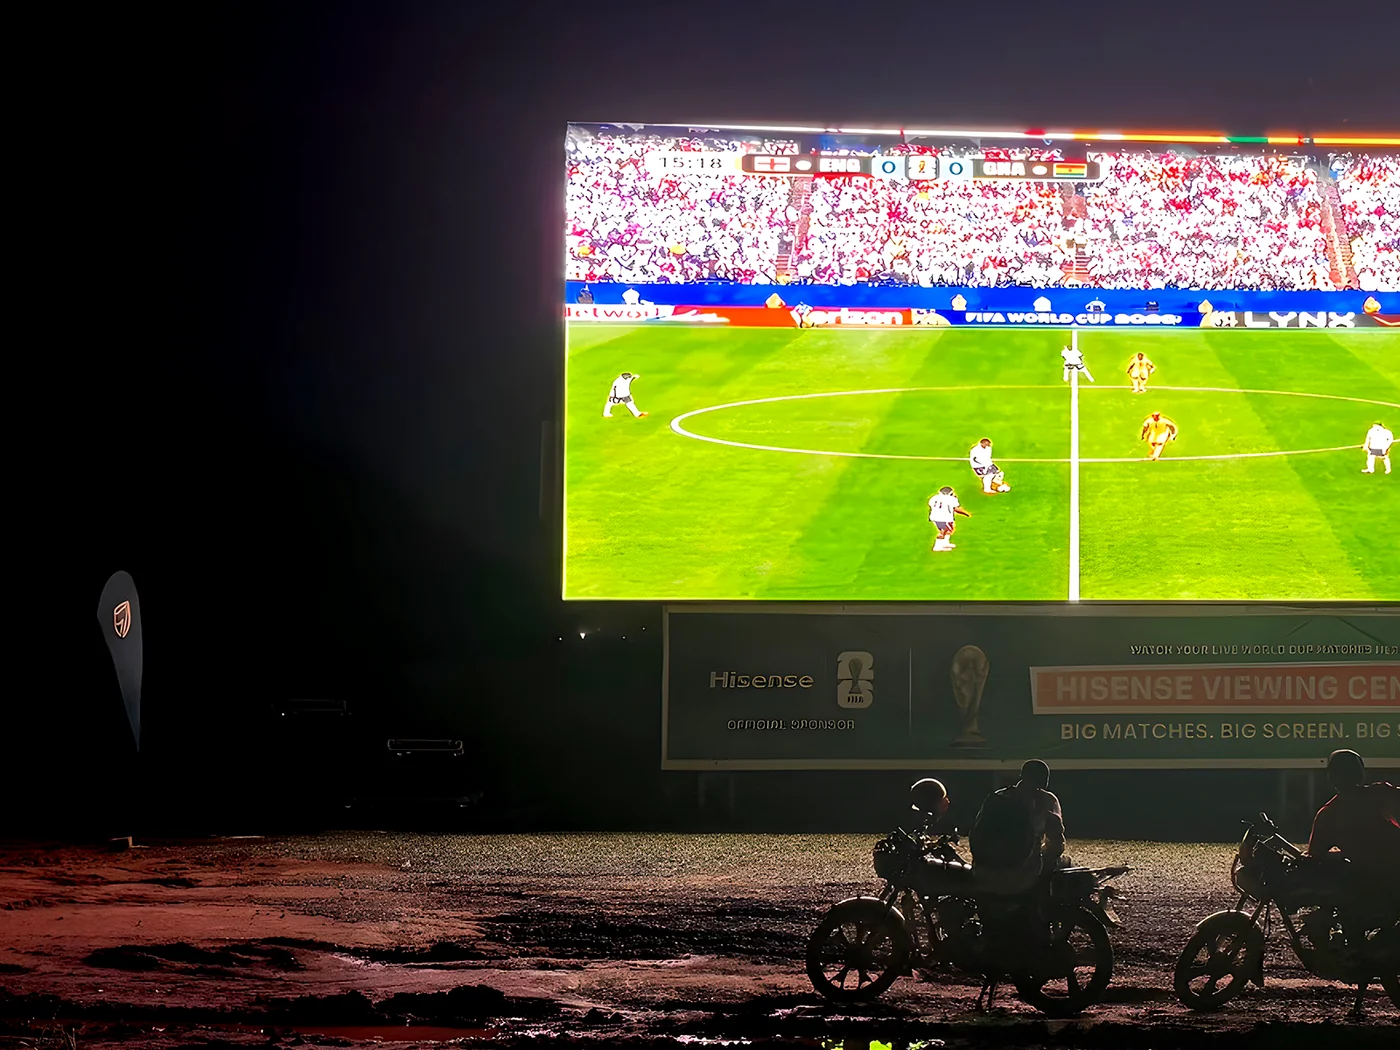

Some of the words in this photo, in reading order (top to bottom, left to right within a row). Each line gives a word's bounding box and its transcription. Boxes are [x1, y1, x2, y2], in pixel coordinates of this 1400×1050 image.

[658, 156, 723, 169] 15:18
[1006, 311, 1075, 324] WORLD
[1075, 312, 1113, 325] CUP
[1244, 310, 1356, 328] LYNX
[709, 671, 814, 689] Hisense
[1056, 675, 1194, 702] HISENSE
[1201, 675, 1339, 701] VIEWING
[1061, 722, 1097, 740] BIG
[1103, 722, 1215, 740] MATCHES.
[1220, 722, 1257, 740] BIG
[1262, 722, 1350, 740] SCREEN.
[1356, 722, 1391, 739] BIG
